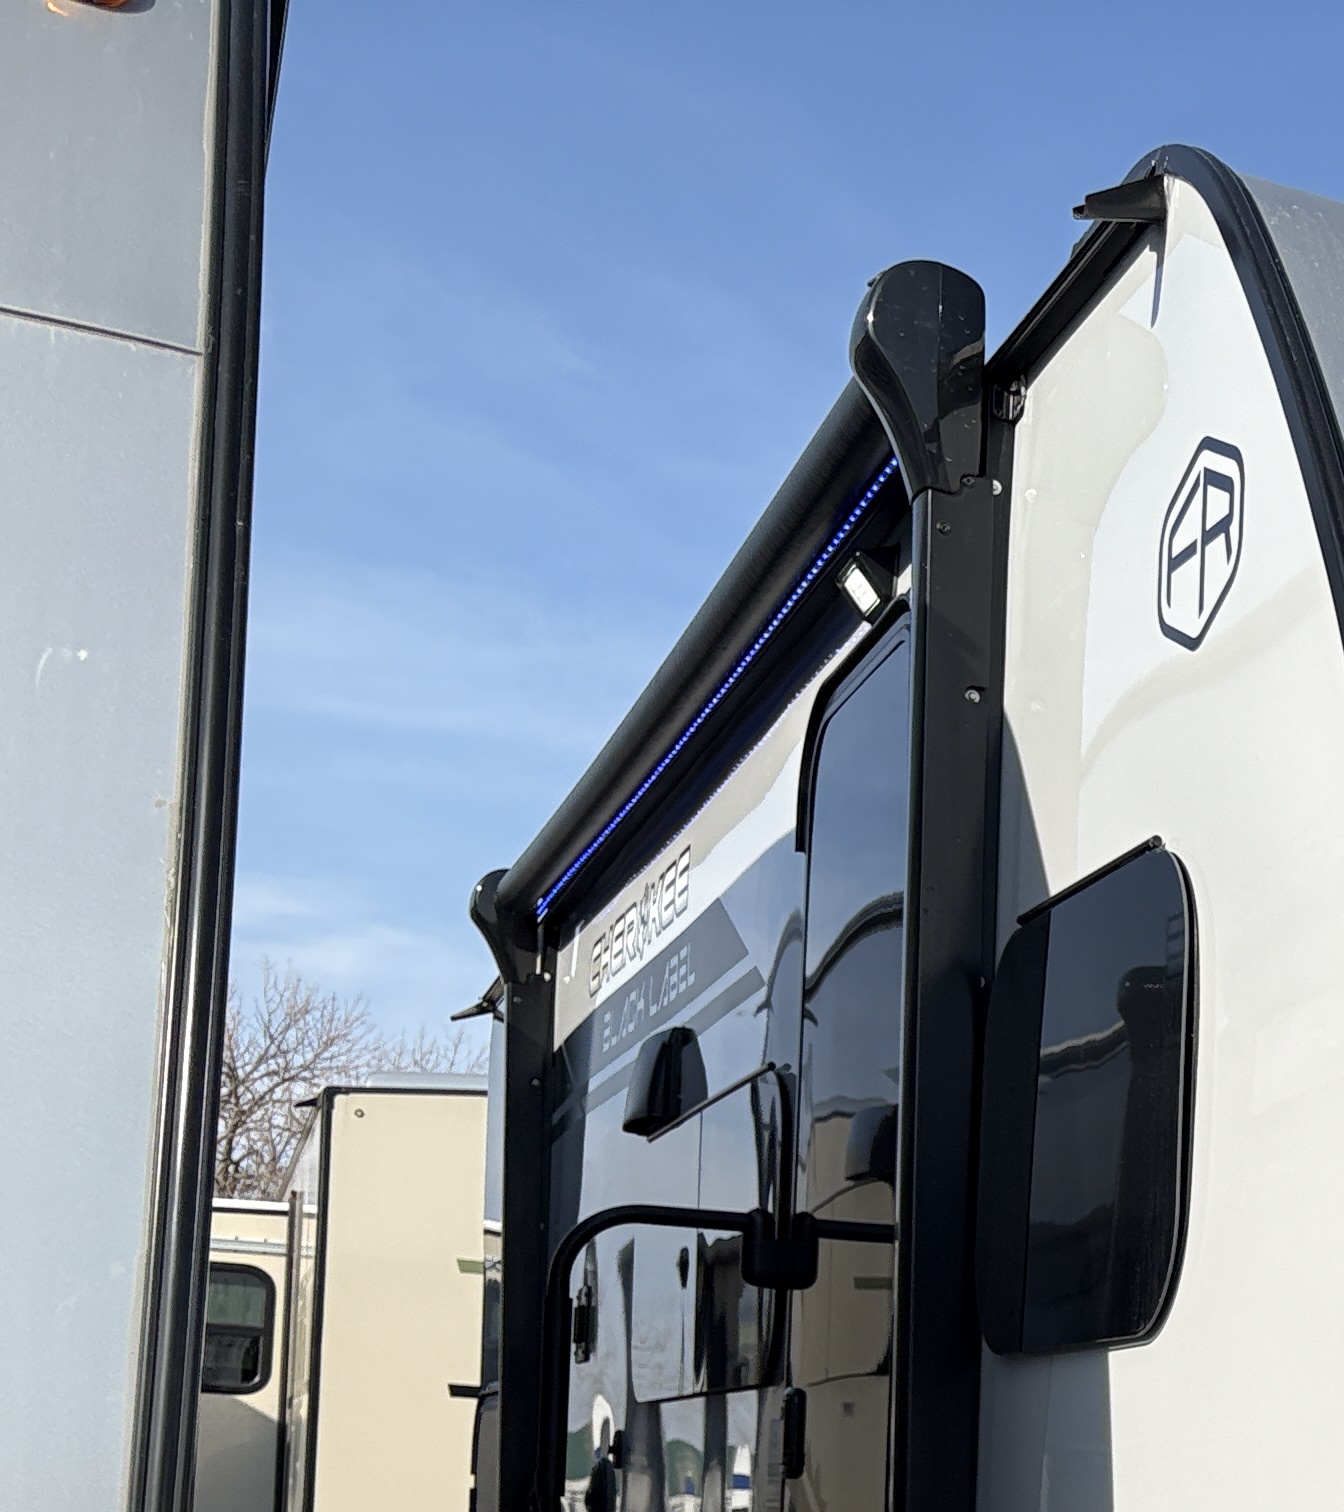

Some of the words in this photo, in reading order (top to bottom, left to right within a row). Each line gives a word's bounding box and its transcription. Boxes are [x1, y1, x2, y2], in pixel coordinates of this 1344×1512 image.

[589, 844, 691, 998] CHERKEE
[603, 981, 646, 1053] BLACK
[649, 943, 696, 1017] LABEL
